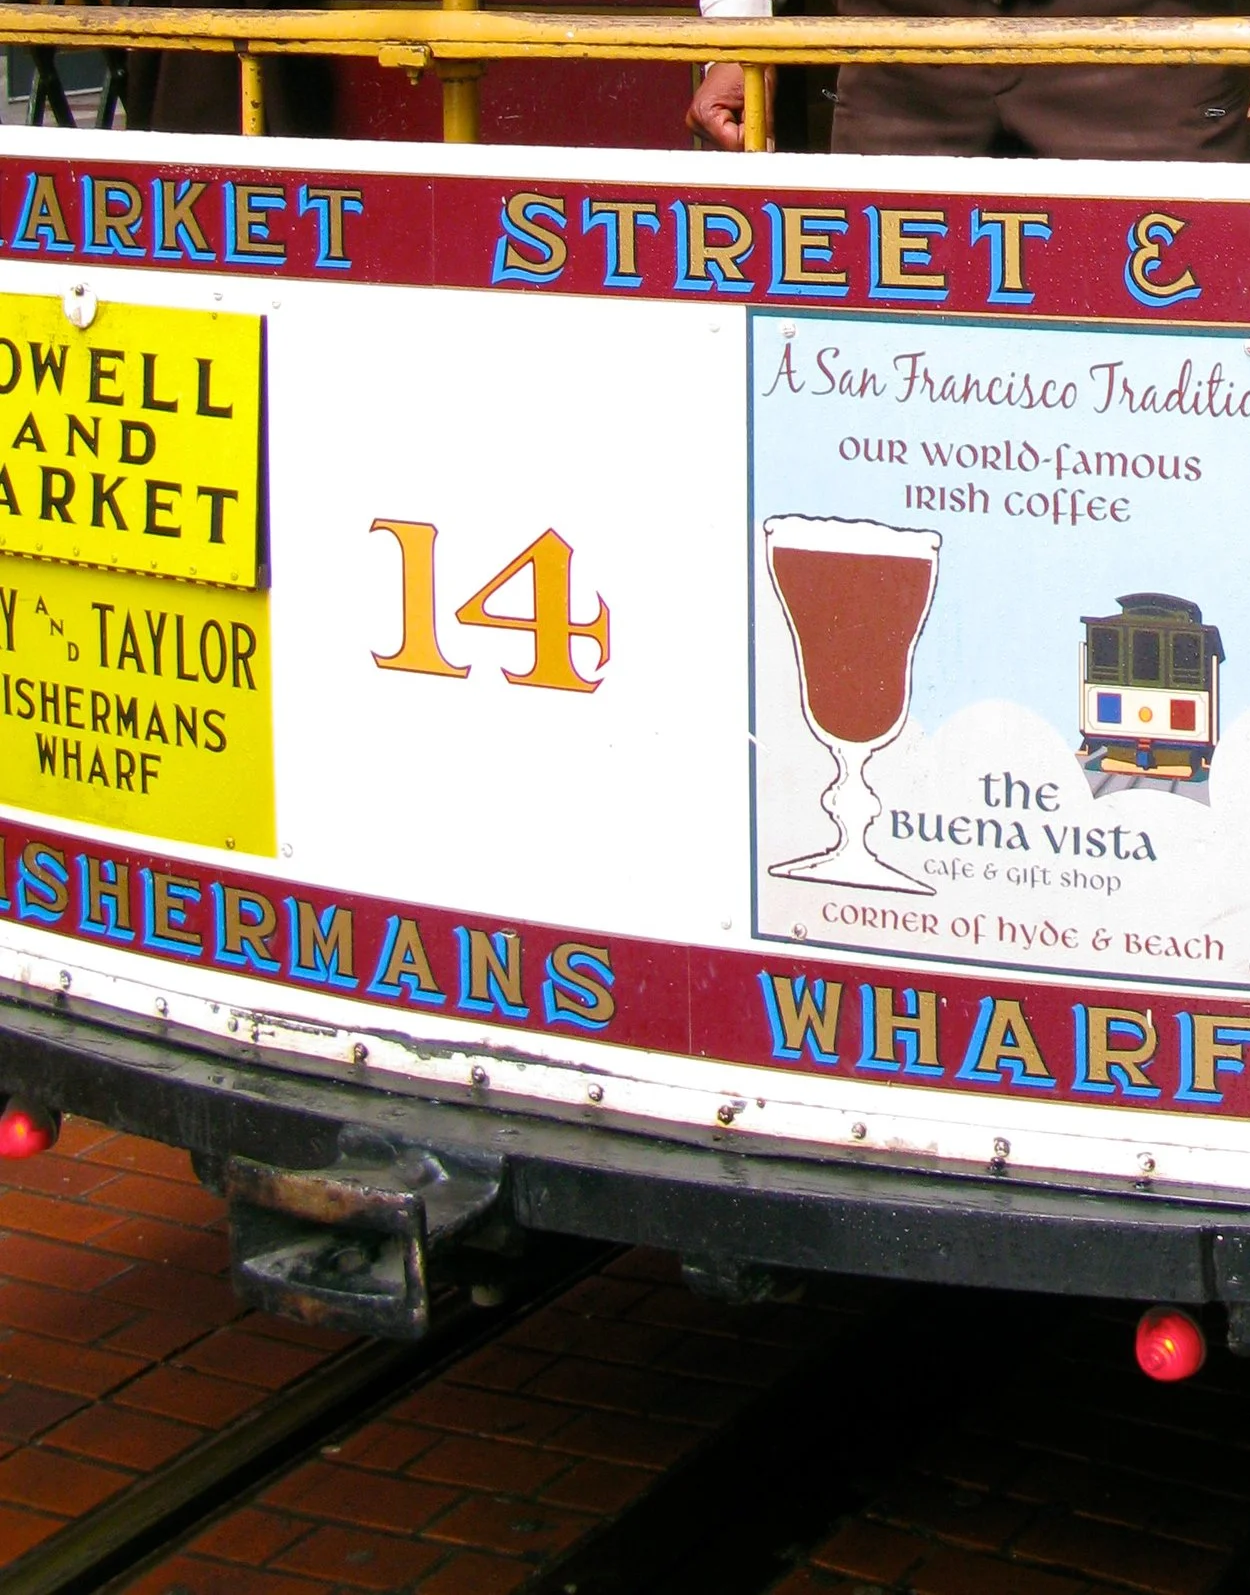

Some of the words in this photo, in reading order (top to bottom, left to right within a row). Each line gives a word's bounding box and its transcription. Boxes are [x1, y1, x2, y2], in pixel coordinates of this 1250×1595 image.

[0, 171, 364, 271] ARKET
[492, 190, 1051, 306] STREET
[1124, 210, 1203, 309] &
[762, 342, 805, 397] A
[811, 347, 887, 399] San
[893, 351, 1078, 410] Francisco
[12, 411, 158, 467] AND
[369, 517, 611, 695] 14
[92, 601, 257, 691] TAYLOR
[35, 731, 163, 795] WHARF
[983, 862, 999, 881] &
[1091, 927, 1113, 952] &
